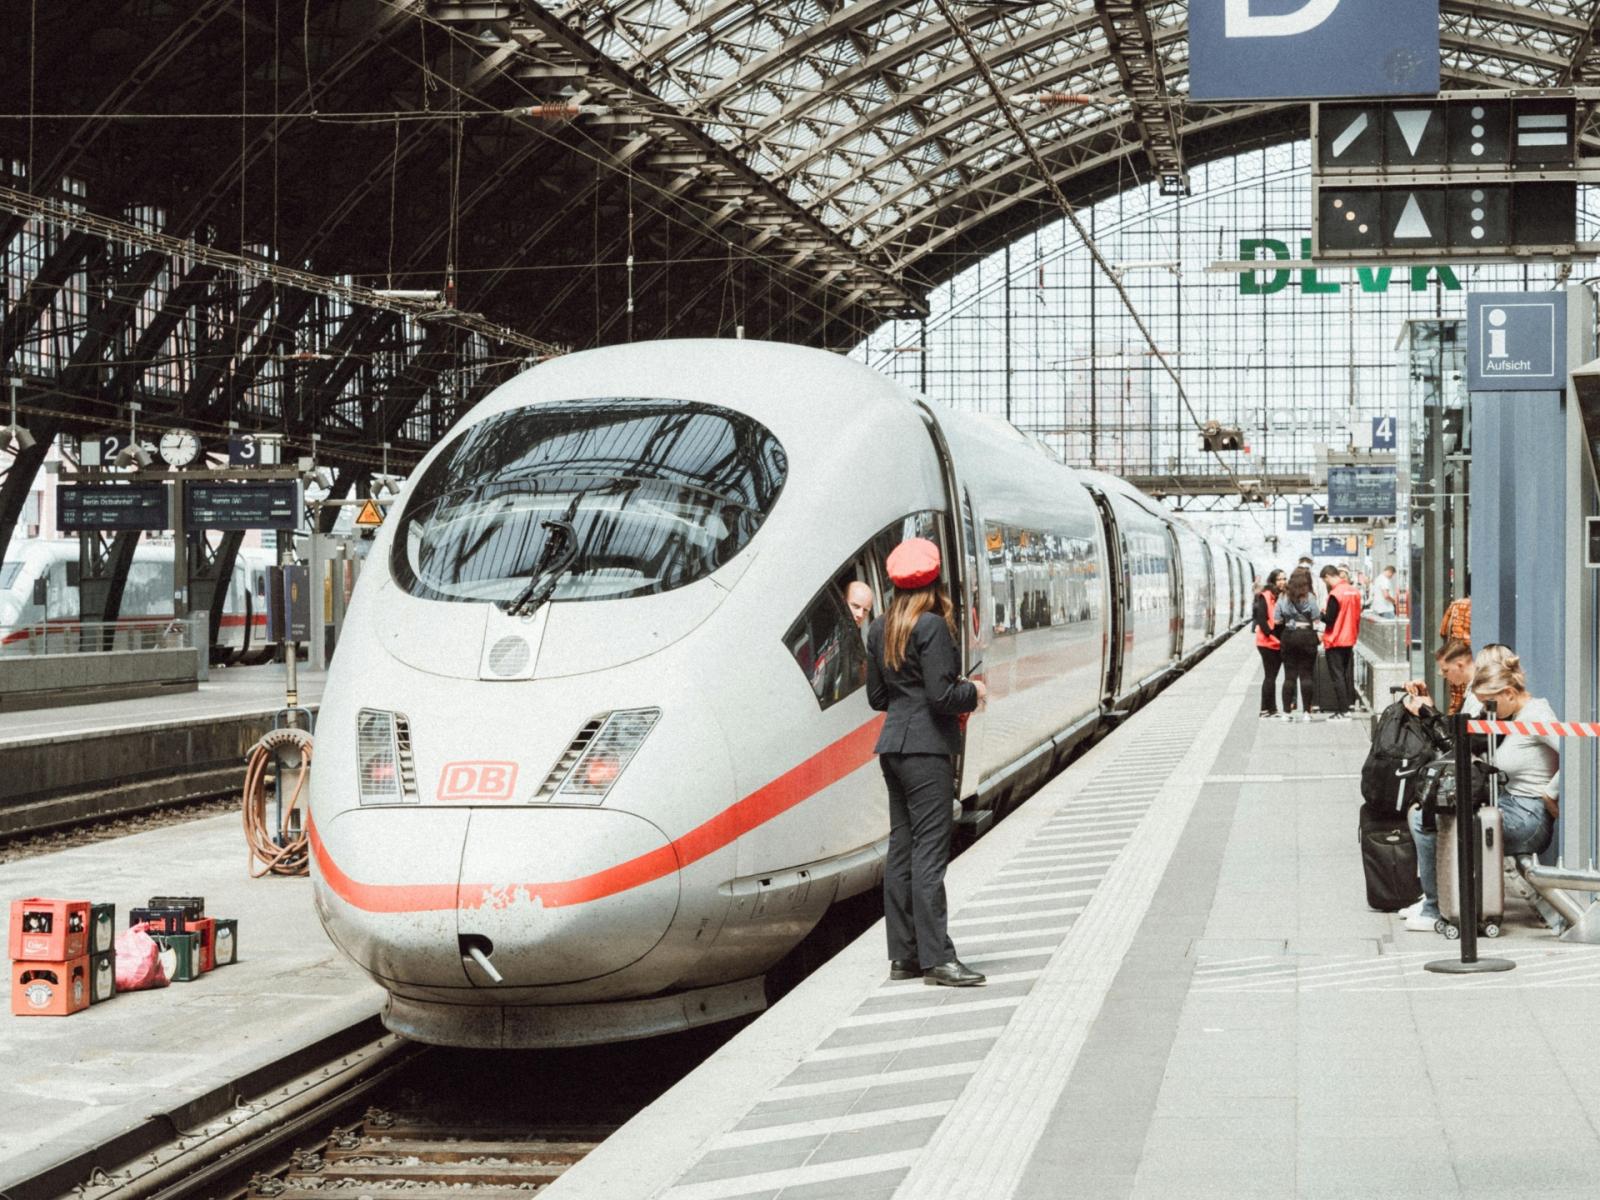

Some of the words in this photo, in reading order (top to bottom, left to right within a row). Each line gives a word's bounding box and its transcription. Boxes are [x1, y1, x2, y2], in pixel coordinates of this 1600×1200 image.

[1486, 360, 1531, 371] Aufsicht
[1376, 419, 1392, 441] 4
[104, 437, 117, 459] 2
[240, 435, 255, 458] 3
[1289, 505, 1303, 525] E
[447, 766, 507, 794] DB
